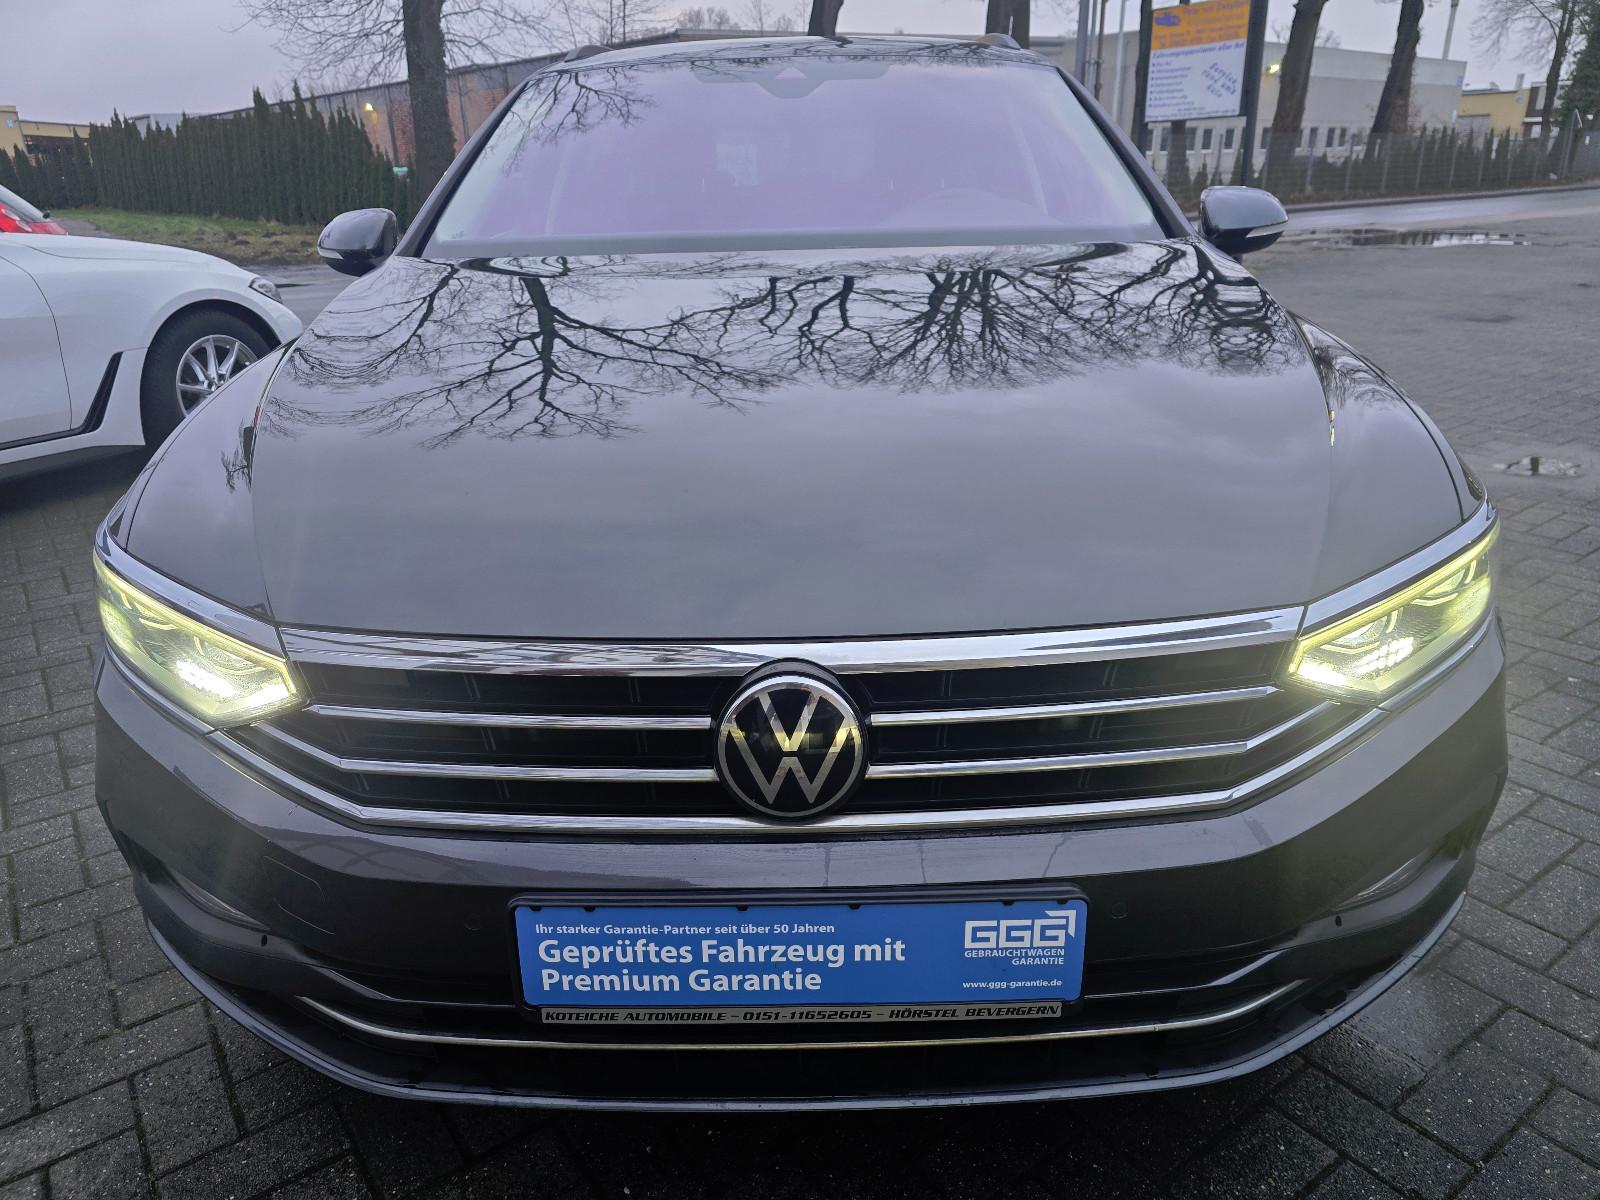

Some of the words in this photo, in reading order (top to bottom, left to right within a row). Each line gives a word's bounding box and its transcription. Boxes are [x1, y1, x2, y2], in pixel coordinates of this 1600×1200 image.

[535, 924, 553, 934] Ihr
[556, 924, 600, 934] starker
[603, 924, 711, 935] Garantie-Partner
[714, 924, 738, 934] seit
[740, 924, 770, 934] über
[773, 924, 789, 934] 50
[792, 923, 835, 933] Jahren
[964, 918, 1067, 949] GGG
[538, 938, 693, 969] Geprüftes
[701, 938, 845, 968] Fahrzeug
[854, 937, 906, 962] mit
[964, 948, 1065, 958] GEBRAUCHTWAGEN
[1011, 957, 1065, 966] GARANTIE
[541, 968, 680, 992] Premium
[688, 967, 822, 991] Garantie
[962, 979, 1063, 990] www.ggg-garantie.de
[544, 1011, 620, 1021] KOTEICHE
[625, 1011, 727, 1021] AUTOMOBILE
[742, 1010, 873, 1021] 0151-11652605
[888, 1007, 960, 1019] HÖRSTEL
[964, 1005, 1060, 1017] BEVERGERN
